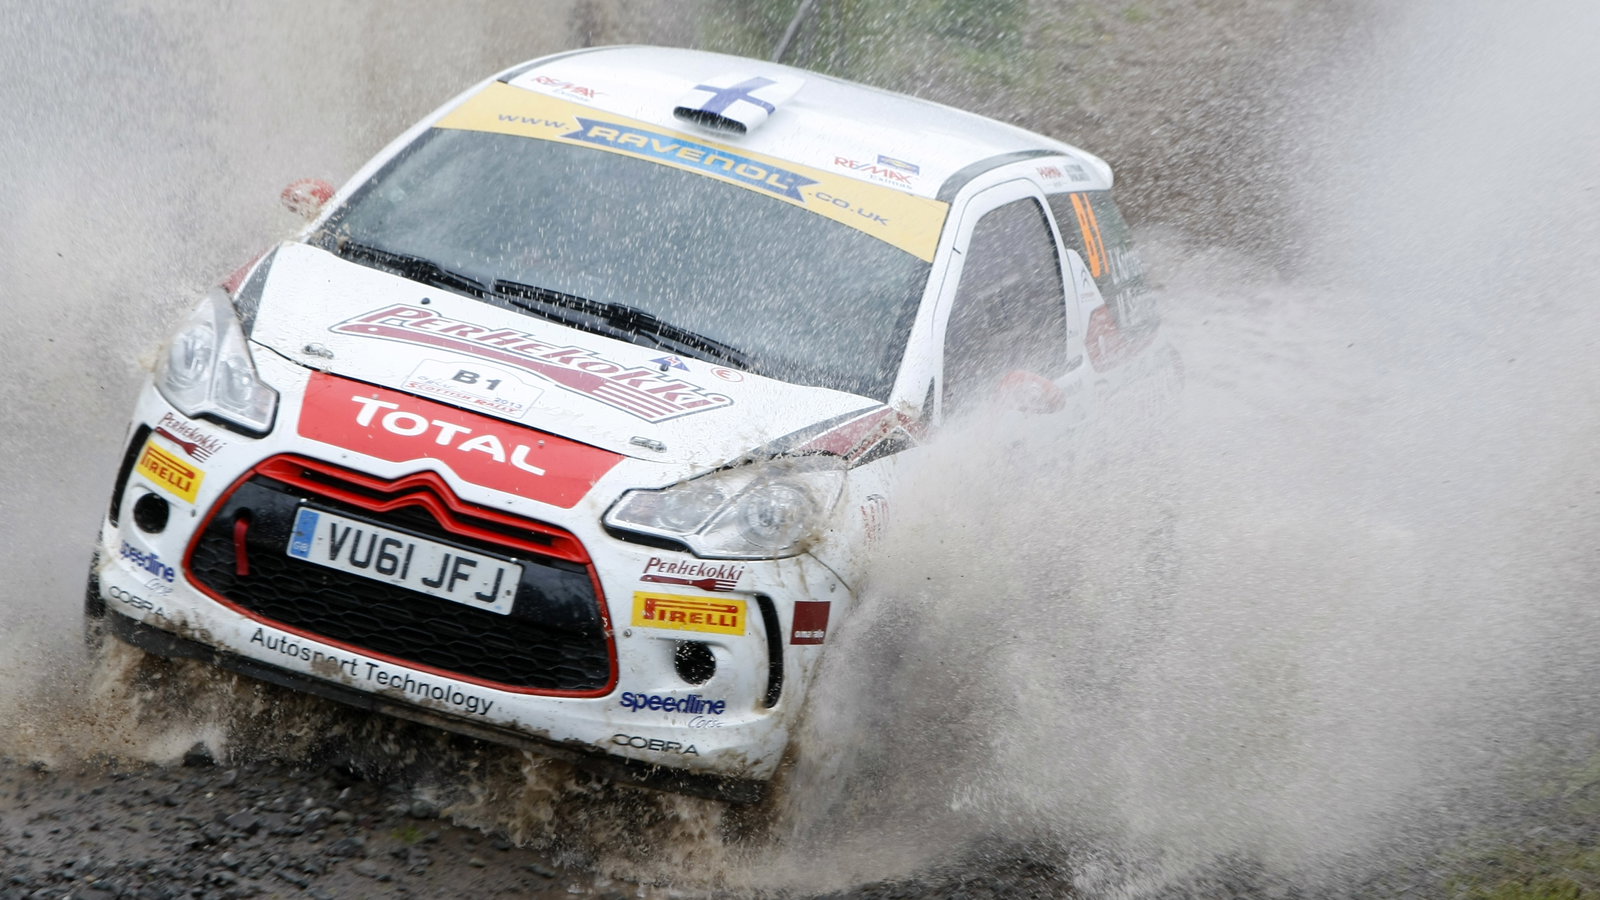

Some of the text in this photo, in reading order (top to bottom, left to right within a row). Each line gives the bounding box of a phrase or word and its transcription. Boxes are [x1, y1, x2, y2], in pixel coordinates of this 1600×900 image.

[587, 125, 790, 190] RAVENOL
[834, 156, 912, 185] RE/MAX
[451, 369, 503, 391] B1
[351, 395, 546, 476] TOTAL
[330, 522, 504, 603] VU61 JFJ
[643, 597, 739, 628] PIRELLI
[365, 662, 493, 716] Technology
[619, 691, 726, 715] speedline
[611, 733, 700, 757] COBRA
